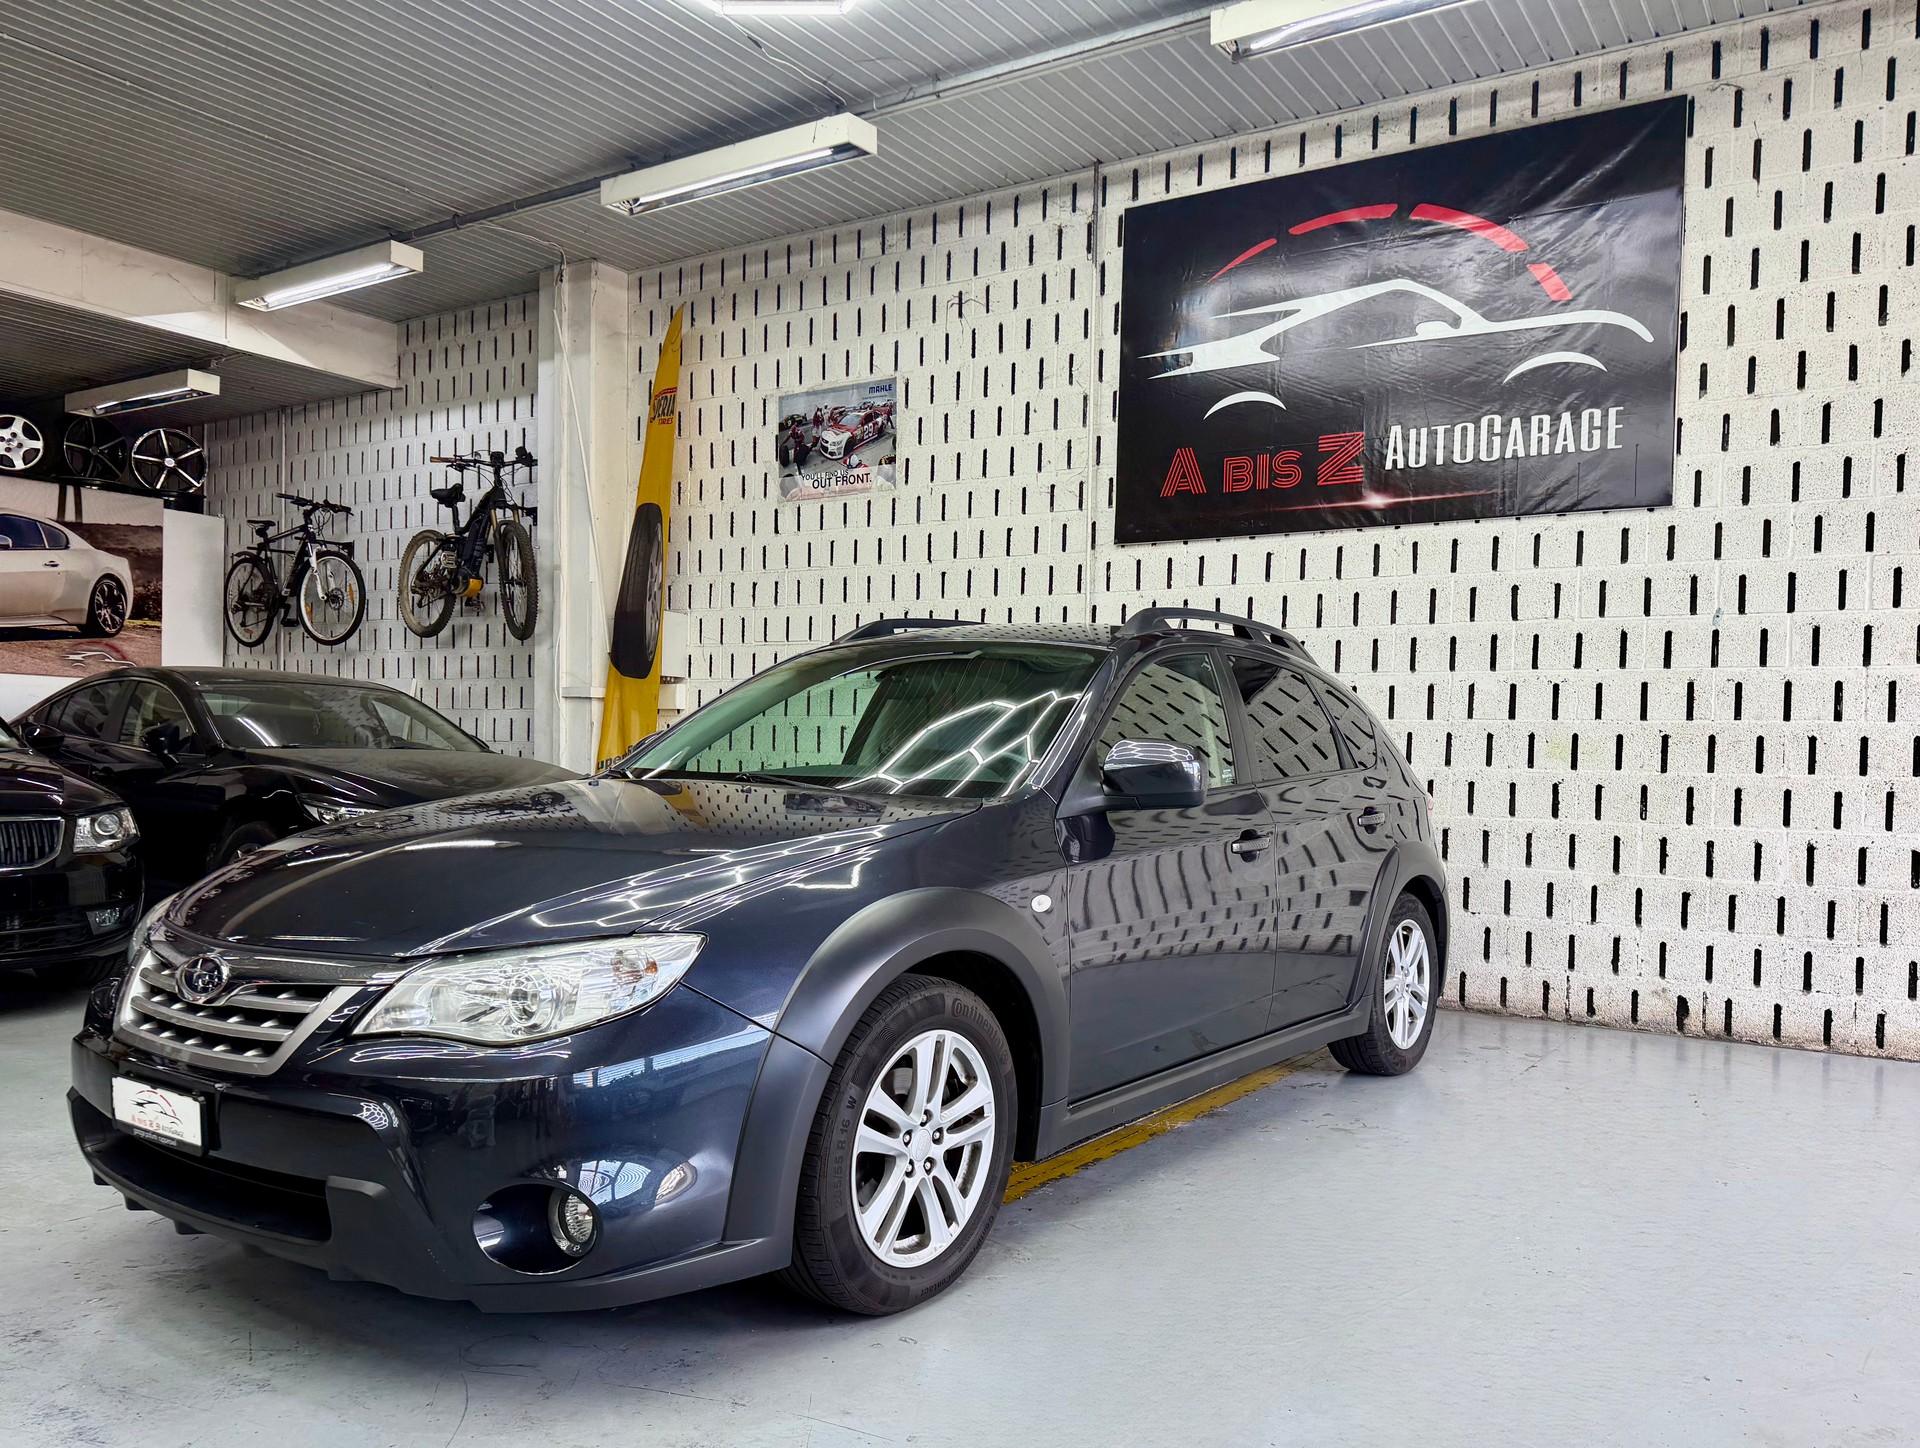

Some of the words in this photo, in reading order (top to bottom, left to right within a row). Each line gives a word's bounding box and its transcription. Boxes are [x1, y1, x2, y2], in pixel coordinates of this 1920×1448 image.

[869, 384, 893, 394] MAHLE
[863, 422, 874, 440] 29
[1160, 447, 1207, 498] A
[1222, 449, 1303, 493] BIS
[1316, 431, 1365, 486] Z
[812, 477, 832, 490] OUT
[835, 472, 872, 487] FRONT.
[951, 997, 1005, 1051] Continental
[846, 1094, 858, 1111] W
[839, 1118, 851, 1135] 16
[836, 1138, 847, 1151] R
